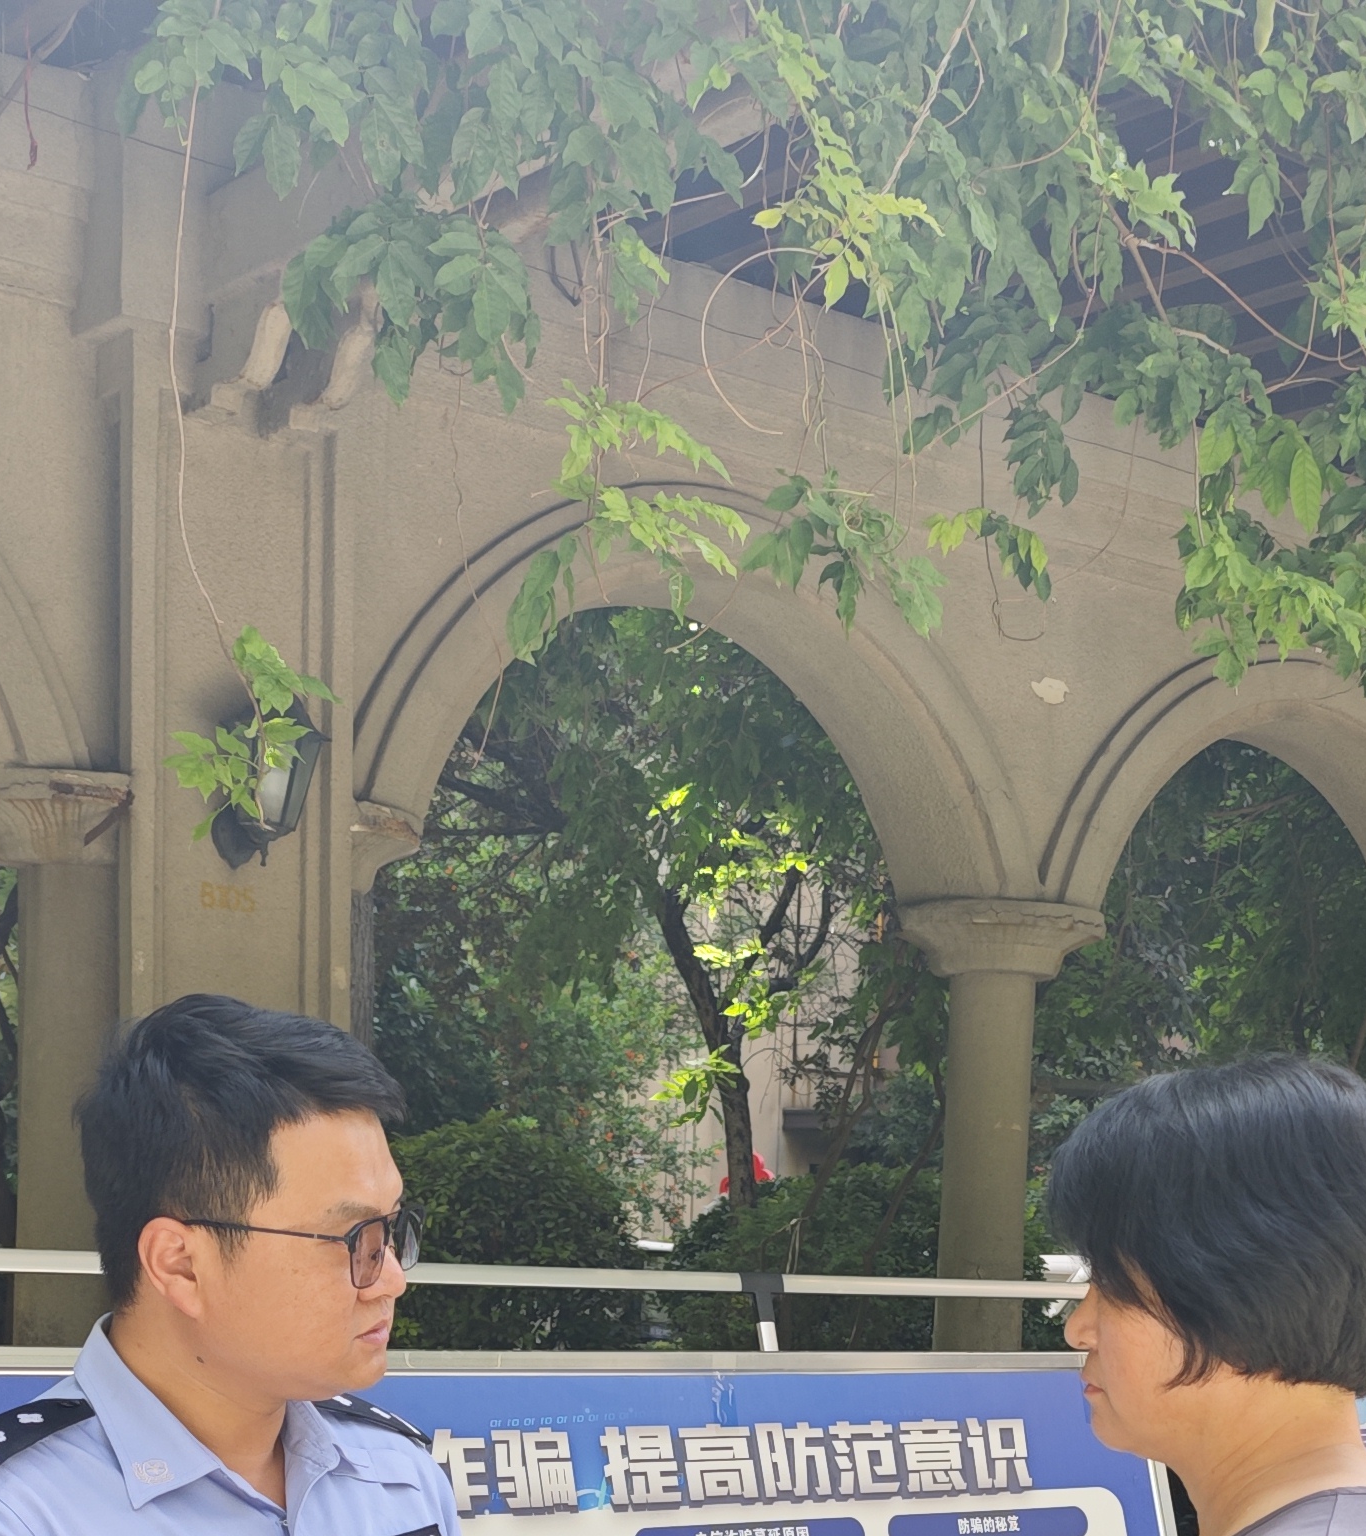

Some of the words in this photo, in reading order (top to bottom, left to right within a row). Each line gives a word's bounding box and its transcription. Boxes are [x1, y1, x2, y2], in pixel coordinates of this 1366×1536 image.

[599, 1418, 1033, 1506] 提高防范意识
[957, 1515, 1020, 1535] 防骗的秘笈
